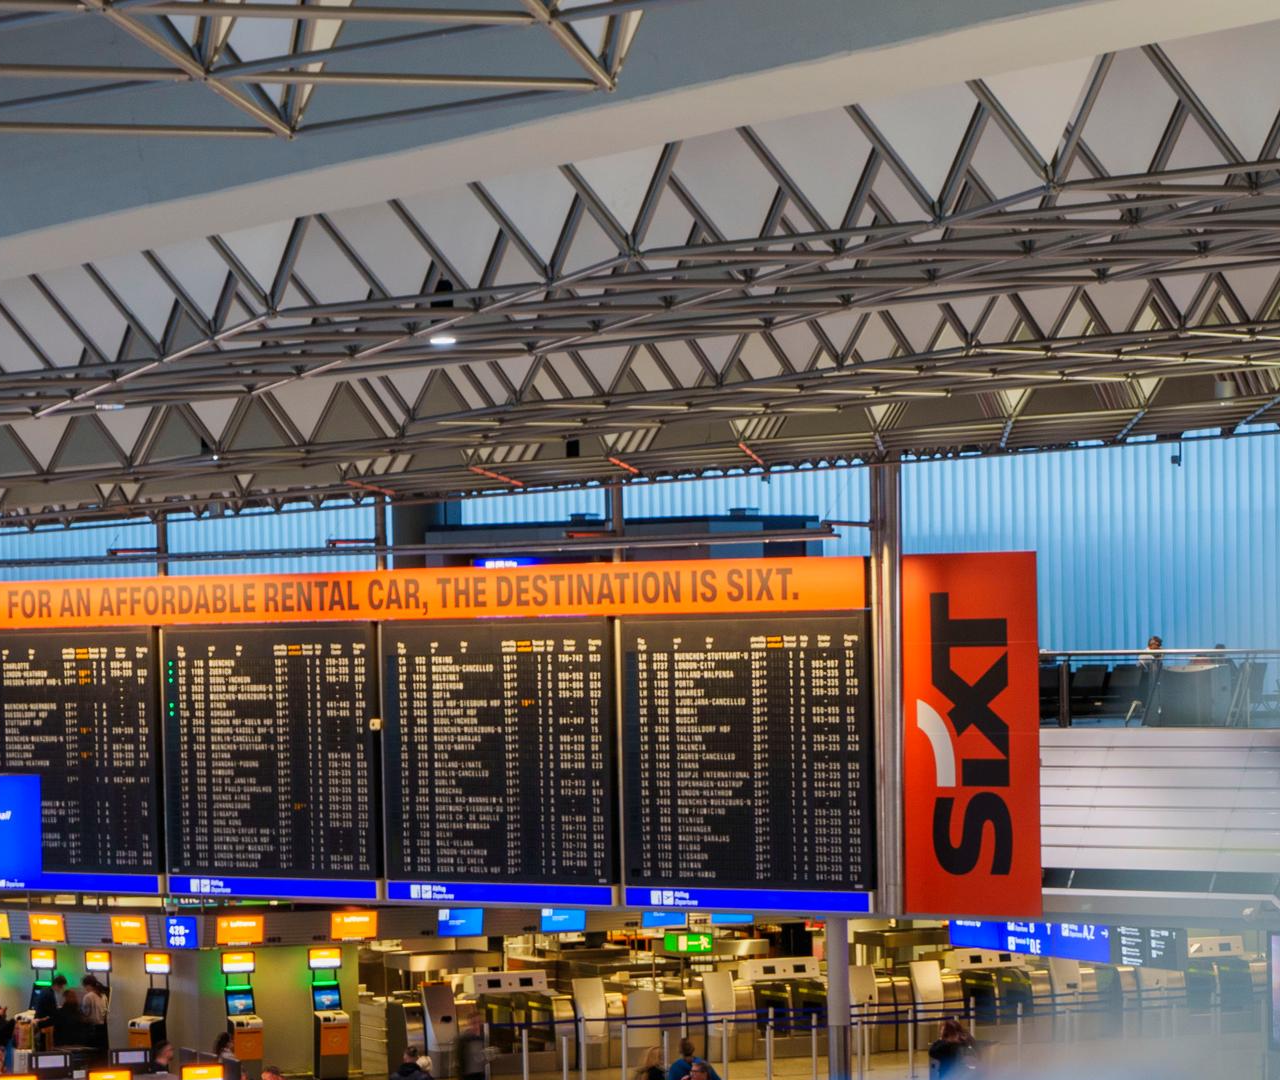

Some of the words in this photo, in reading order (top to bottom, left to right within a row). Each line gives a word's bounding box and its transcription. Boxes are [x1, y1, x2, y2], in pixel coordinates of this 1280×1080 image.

[7, 589, 52, 618] FOR
[61, 588, 91, 617] AN
[99, 583, 256, 617] AFFORDABLE
[264, 579, 359, 612] RENTAL
[371, 577, 429, 616] CAR,
[437, 574, 488, 609] THE
[496, 570, 681, 607] DESTINATION
[691, 570, 715, 603] IS
[727, 567, 799, 601] SIXT.
[929, 592, 1013, 877] SIXT
